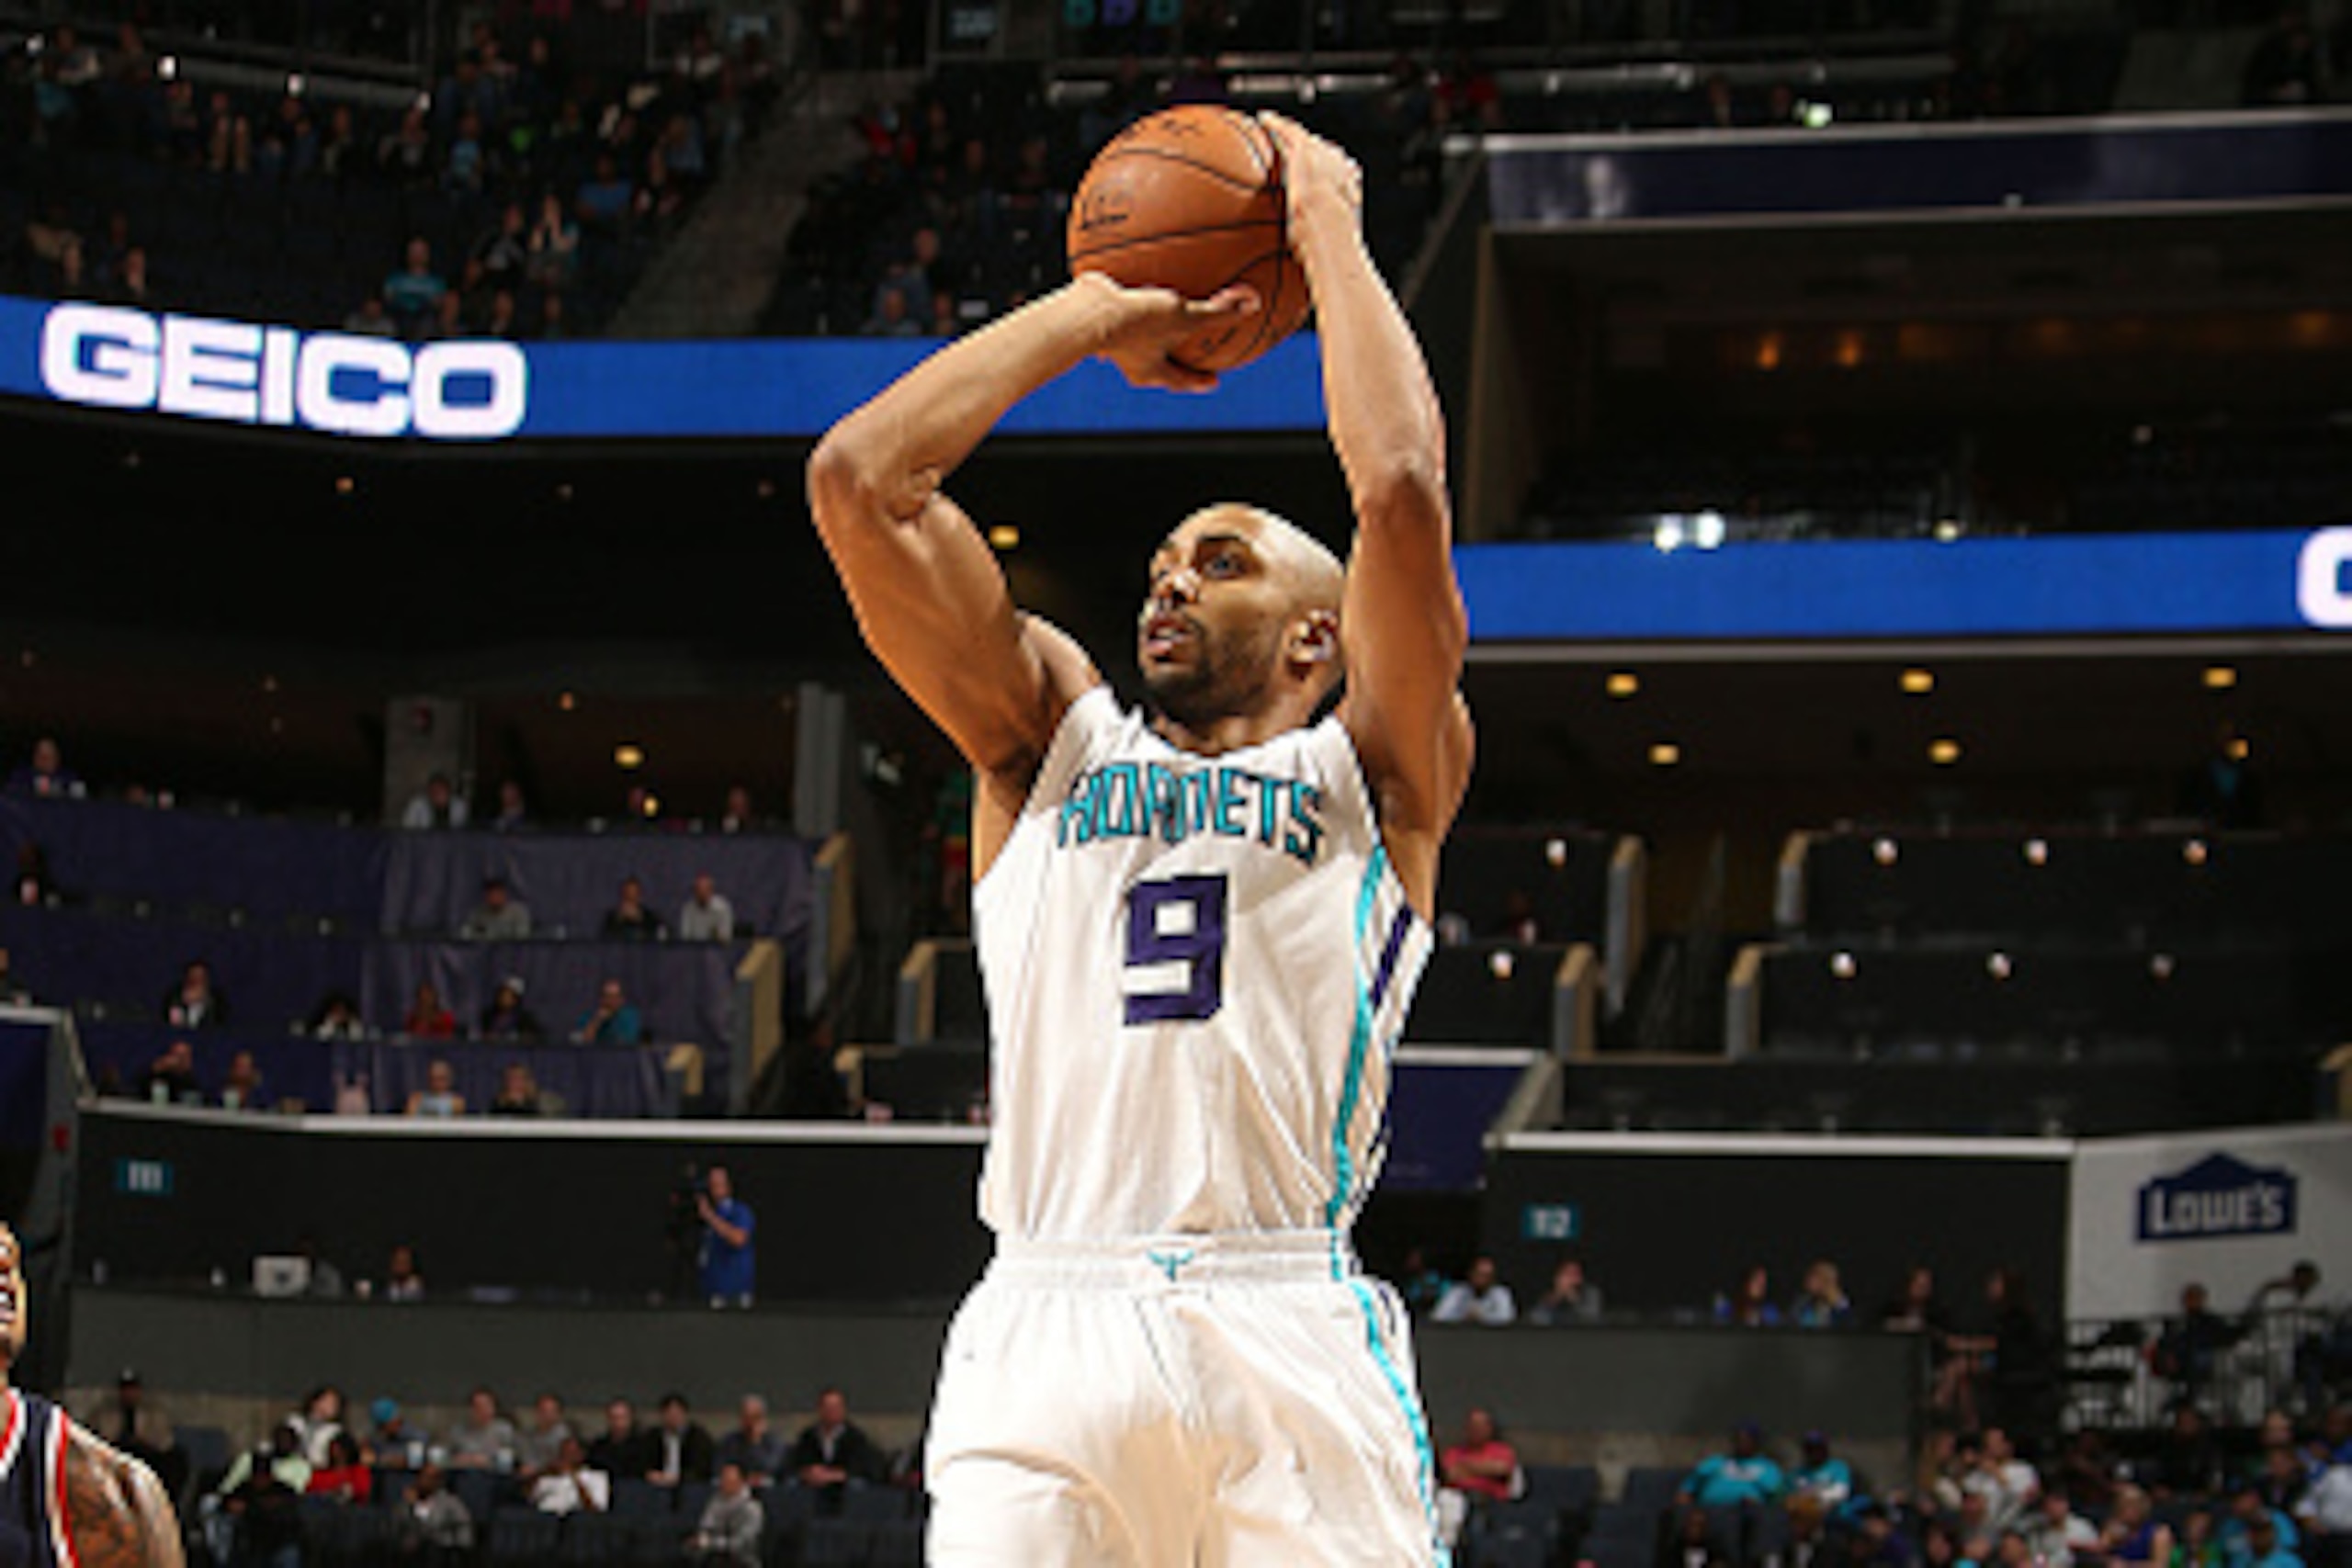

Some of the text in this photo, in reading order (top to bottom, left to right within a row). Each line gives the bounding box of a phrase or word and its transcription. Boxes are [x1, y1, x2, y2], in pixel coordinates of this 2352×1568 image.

[41, 303, 527, 437] GEICO
[1057, 761, 1323, 866] HORNETS
[1123, 874, 1228, 1025] 9
